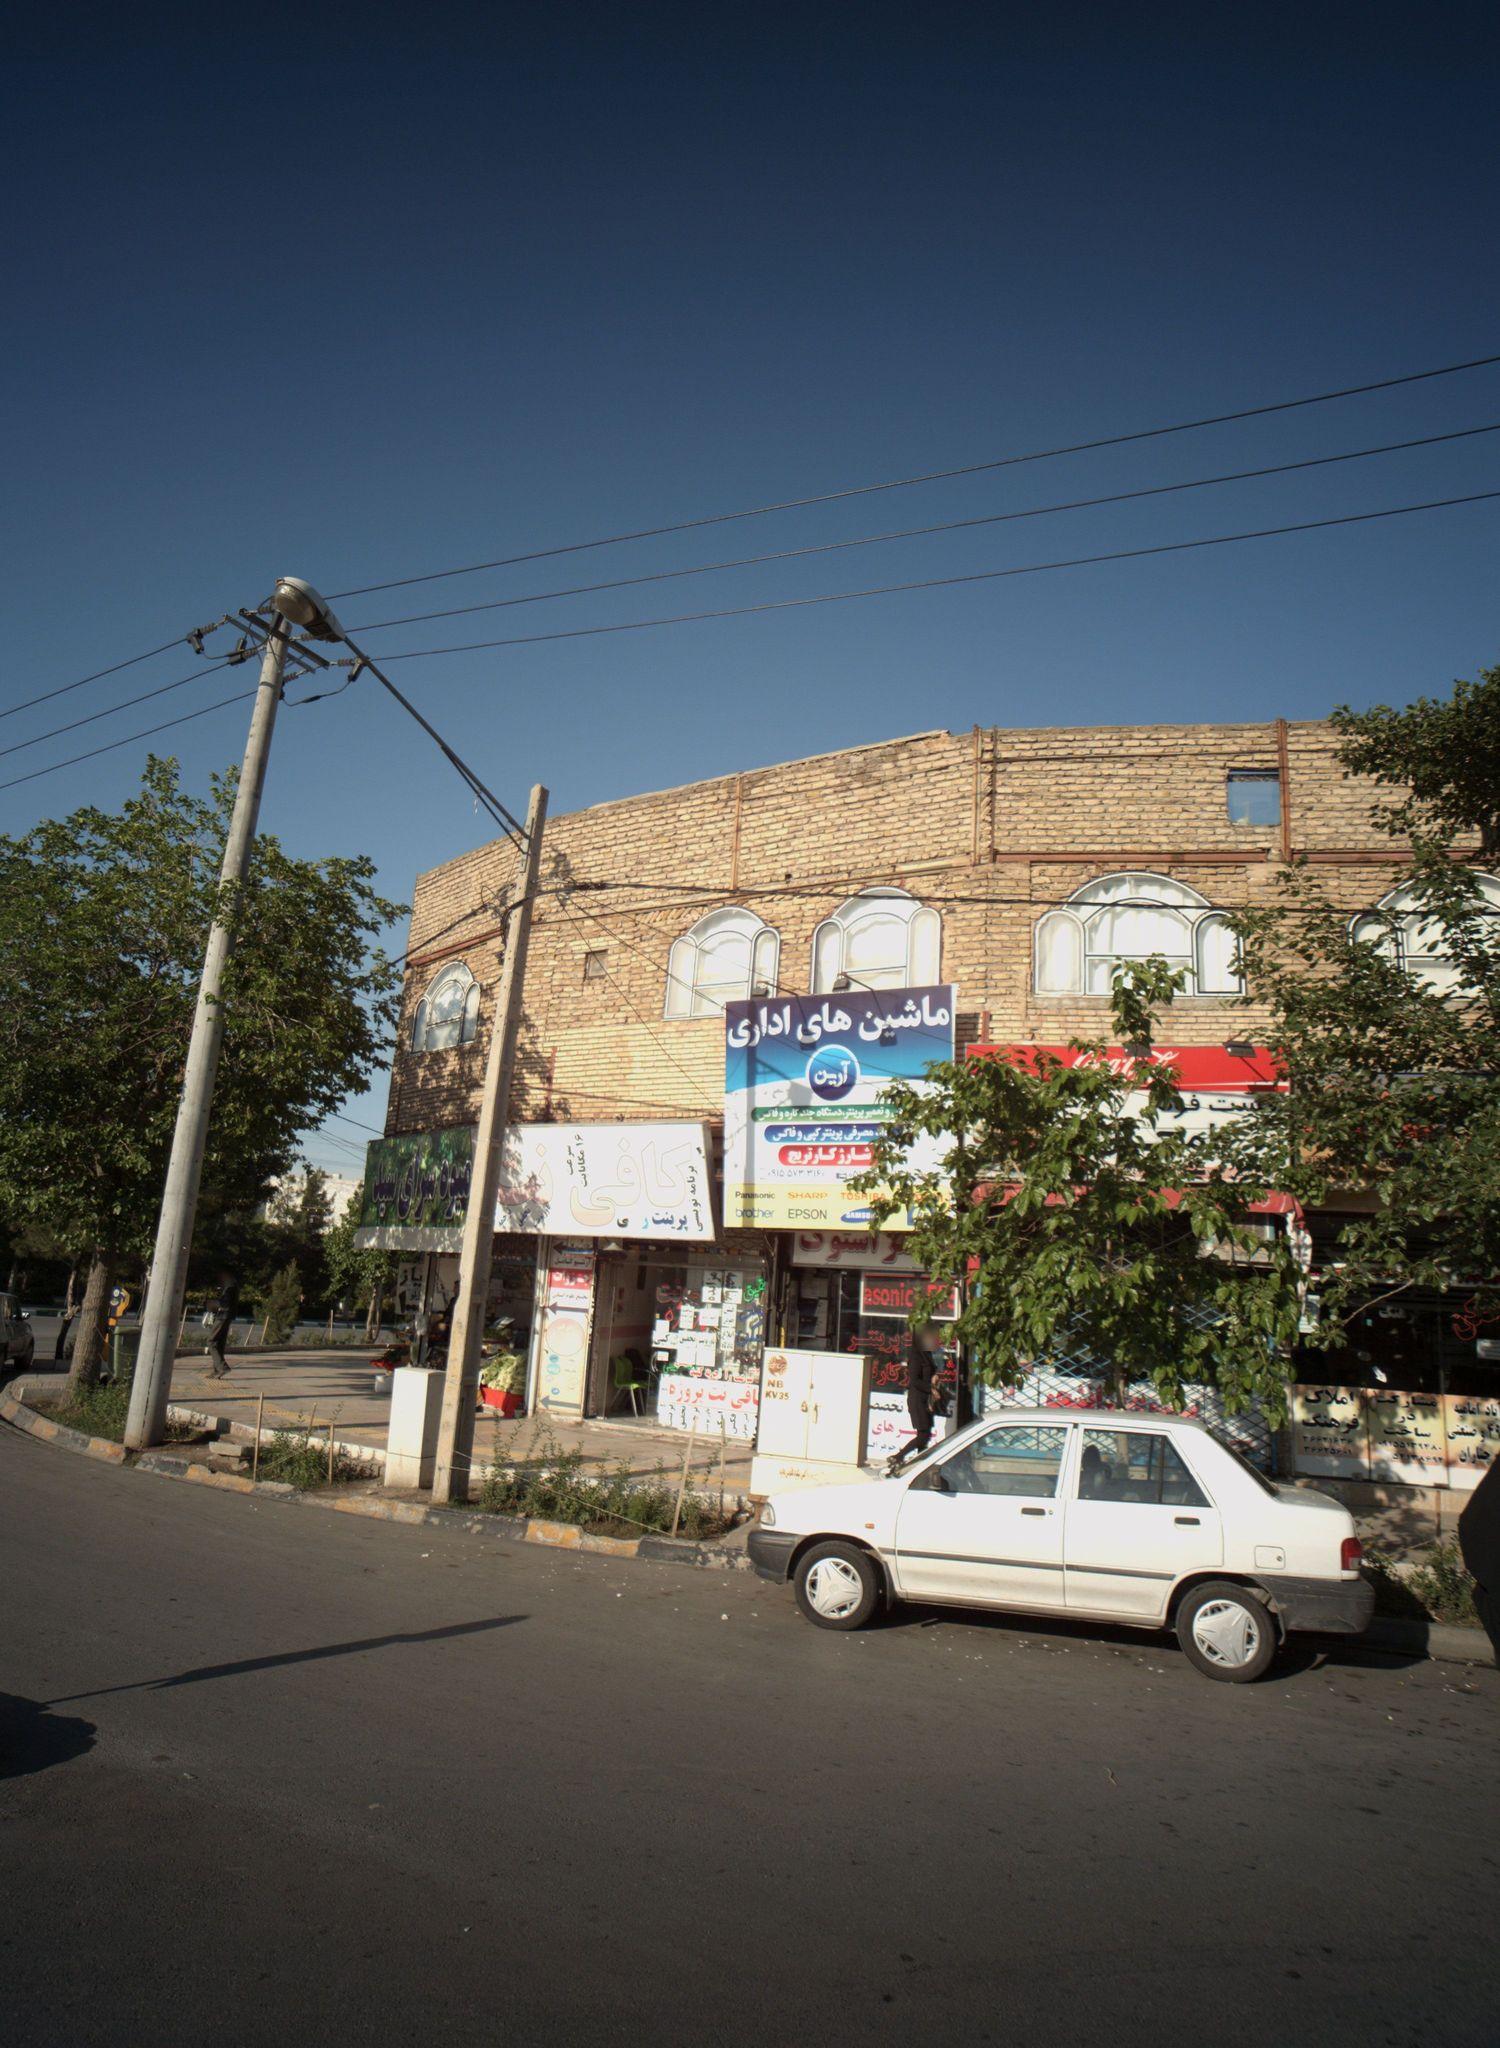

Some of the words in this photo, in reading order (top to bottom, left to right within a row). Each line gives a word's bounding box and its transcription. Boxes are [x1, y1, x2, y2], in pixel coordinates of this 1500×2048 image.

[728, 1006, 791, 1048] اداری
[797, 1003, 852, 1044] های
[858, 996, 949, 1041] ماشین
[815, 1061, 850, 1087] آرین
[844, 1126, 874, 1140] مصرفی
[788, 1146, 838, 1165] کارتریج
[839, 1146, 872, 1164] شارژ
[570, 1137, 692, 1227] کافی
[735, 1191, 775, 1200] Panasonic
[788, 1191, 828, 1200] SHARP
[840, 1192, 887, 1201] TOSHIBA
[652, 1211, 688, 1231] پرینت
[735, 1207, 774, 1218] brother
[787, 1208, 827, 1219] EPSON
[1305, 1389, 1355, 1405] املاک
[1399, 1413, 1416, 1424] در
